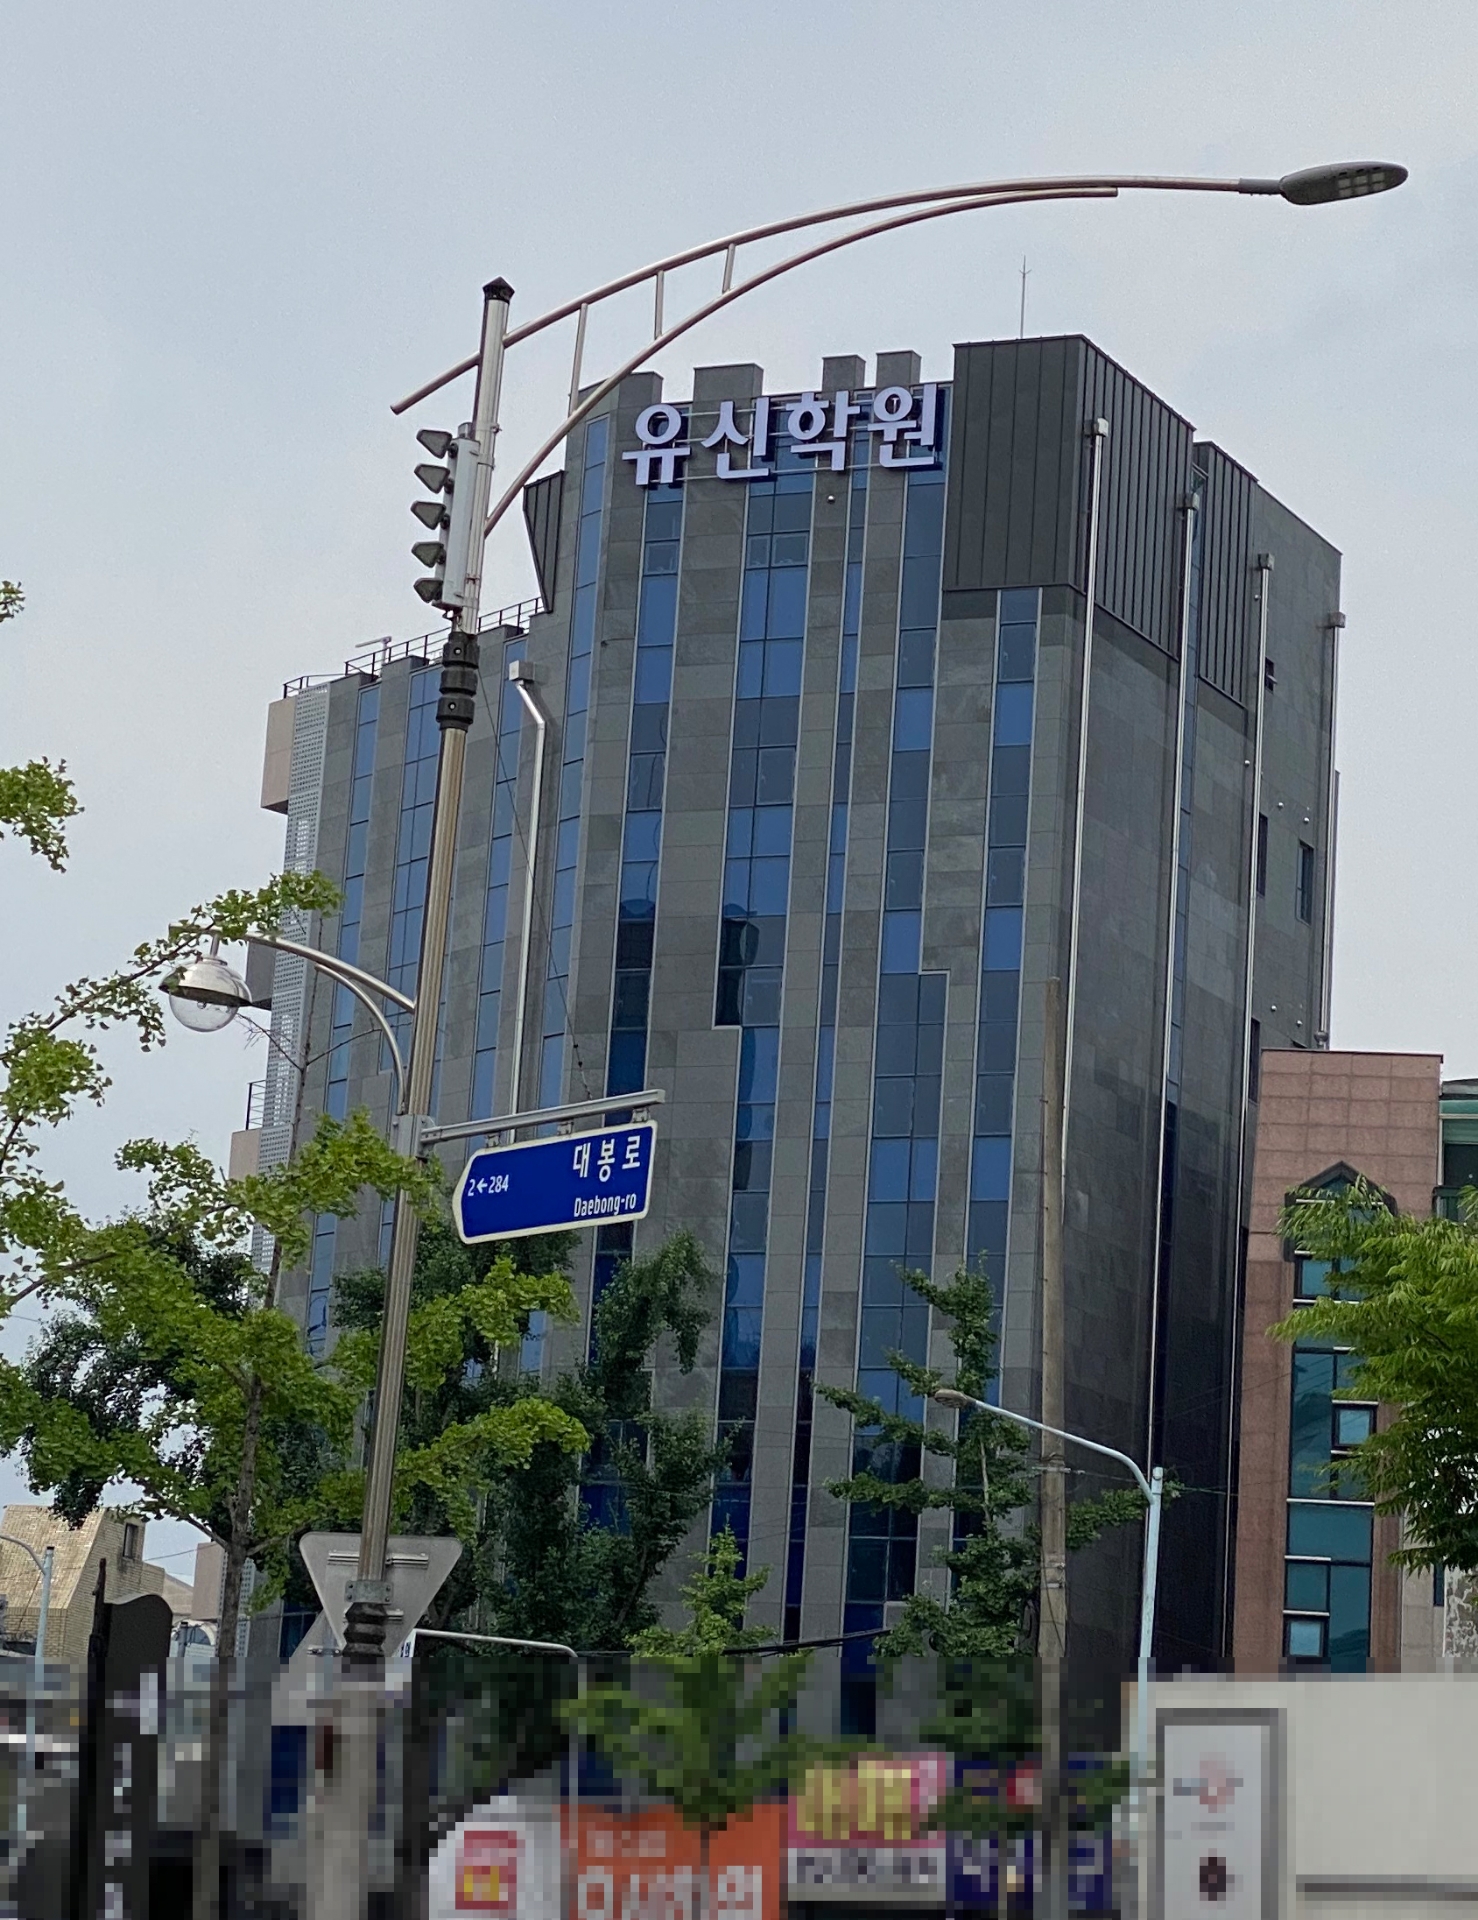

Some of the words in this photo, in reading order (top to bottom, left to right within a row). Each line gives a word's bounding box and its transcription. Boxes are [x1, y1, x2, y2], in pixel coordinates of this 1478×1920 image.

[622, 383, 937, 485] 유신학원
[573, 1135, 641, 1182] 대봉로
[573, 1193, 637, 1217] Daebong-ro
